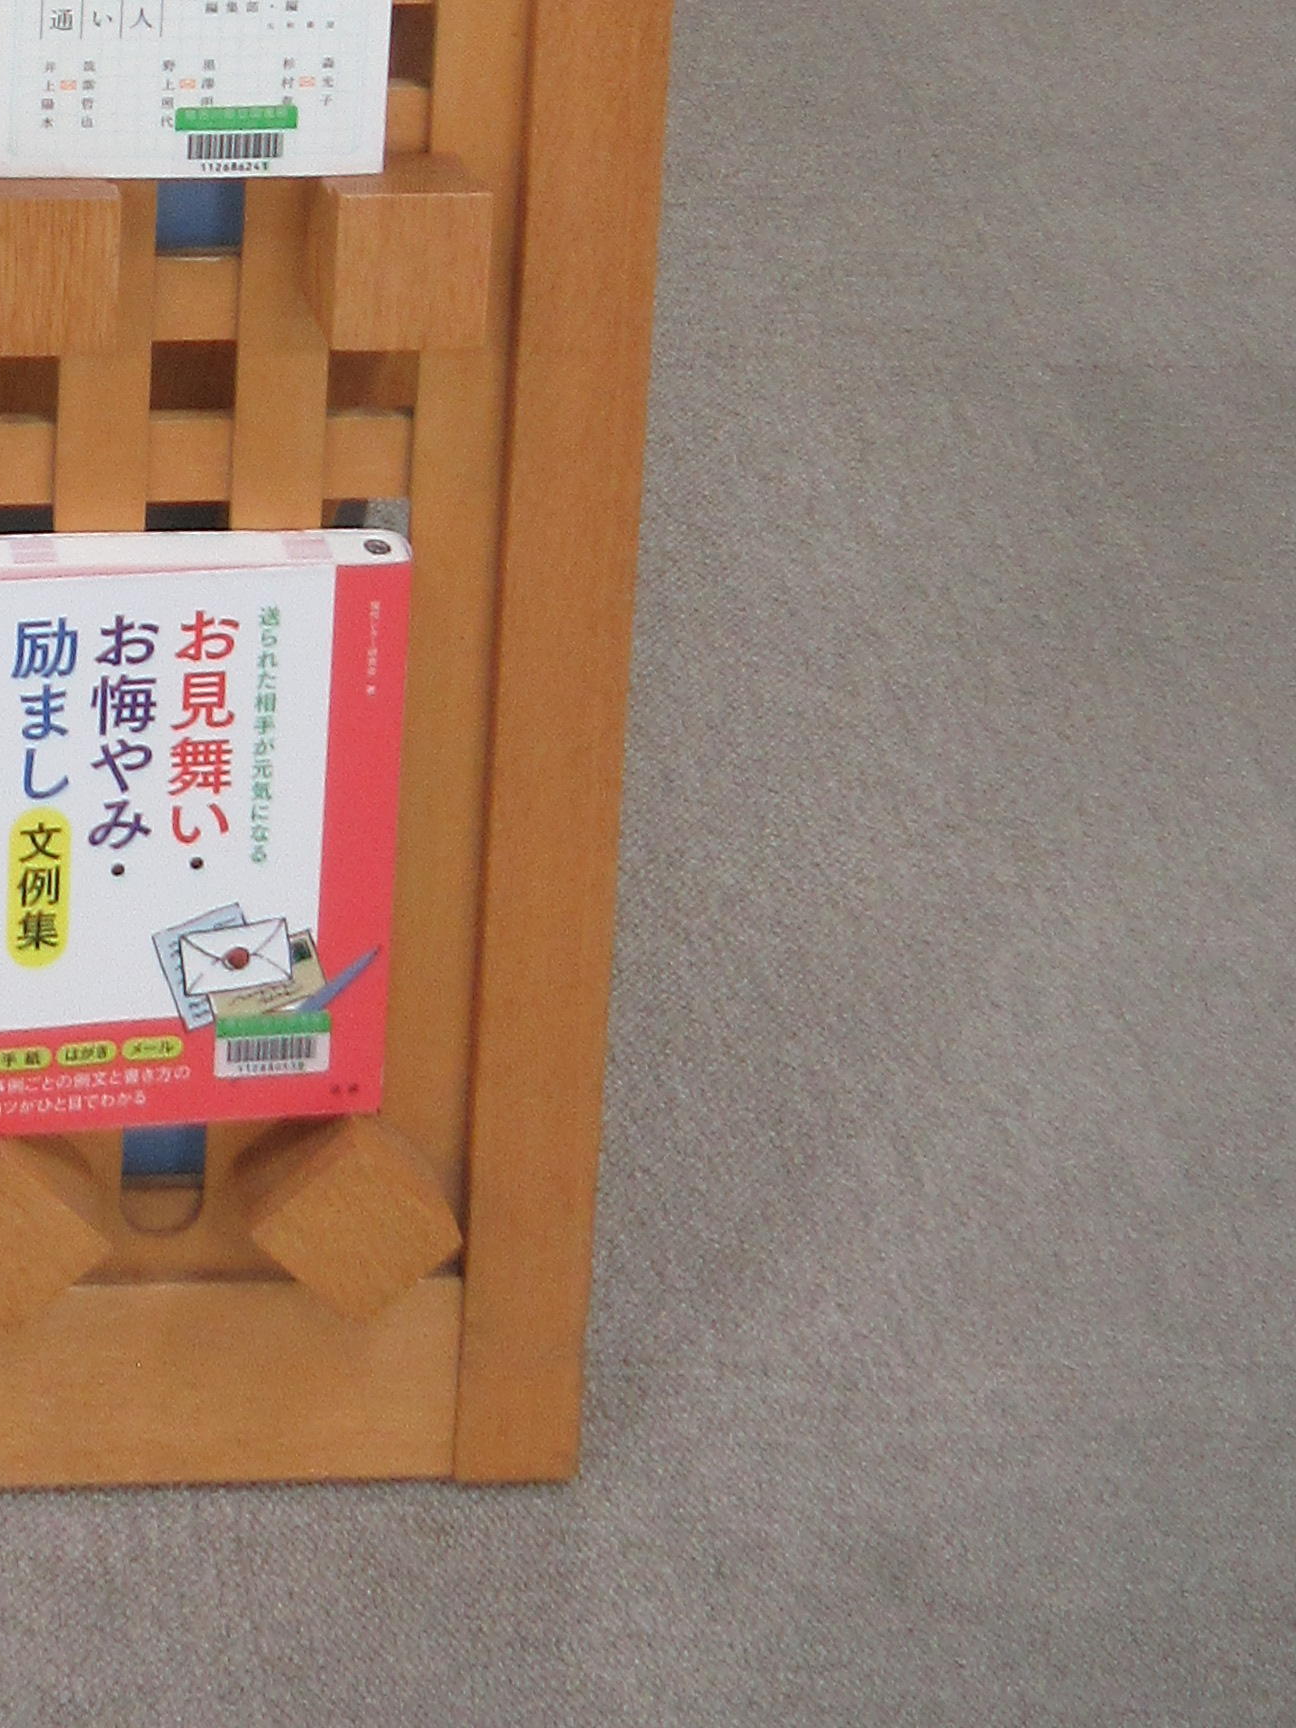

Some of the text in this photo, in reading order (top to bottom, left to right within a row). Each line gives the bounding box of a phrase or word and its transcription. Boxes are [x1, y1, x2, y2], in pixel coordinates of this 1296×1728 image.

[11, 617, 78, 800] 励まし
[251, 605, 280, 864] 送られた相手が元気になる
[17, 822, 60, 951] 文例集
[132, 1041, 181, 1054] メール
